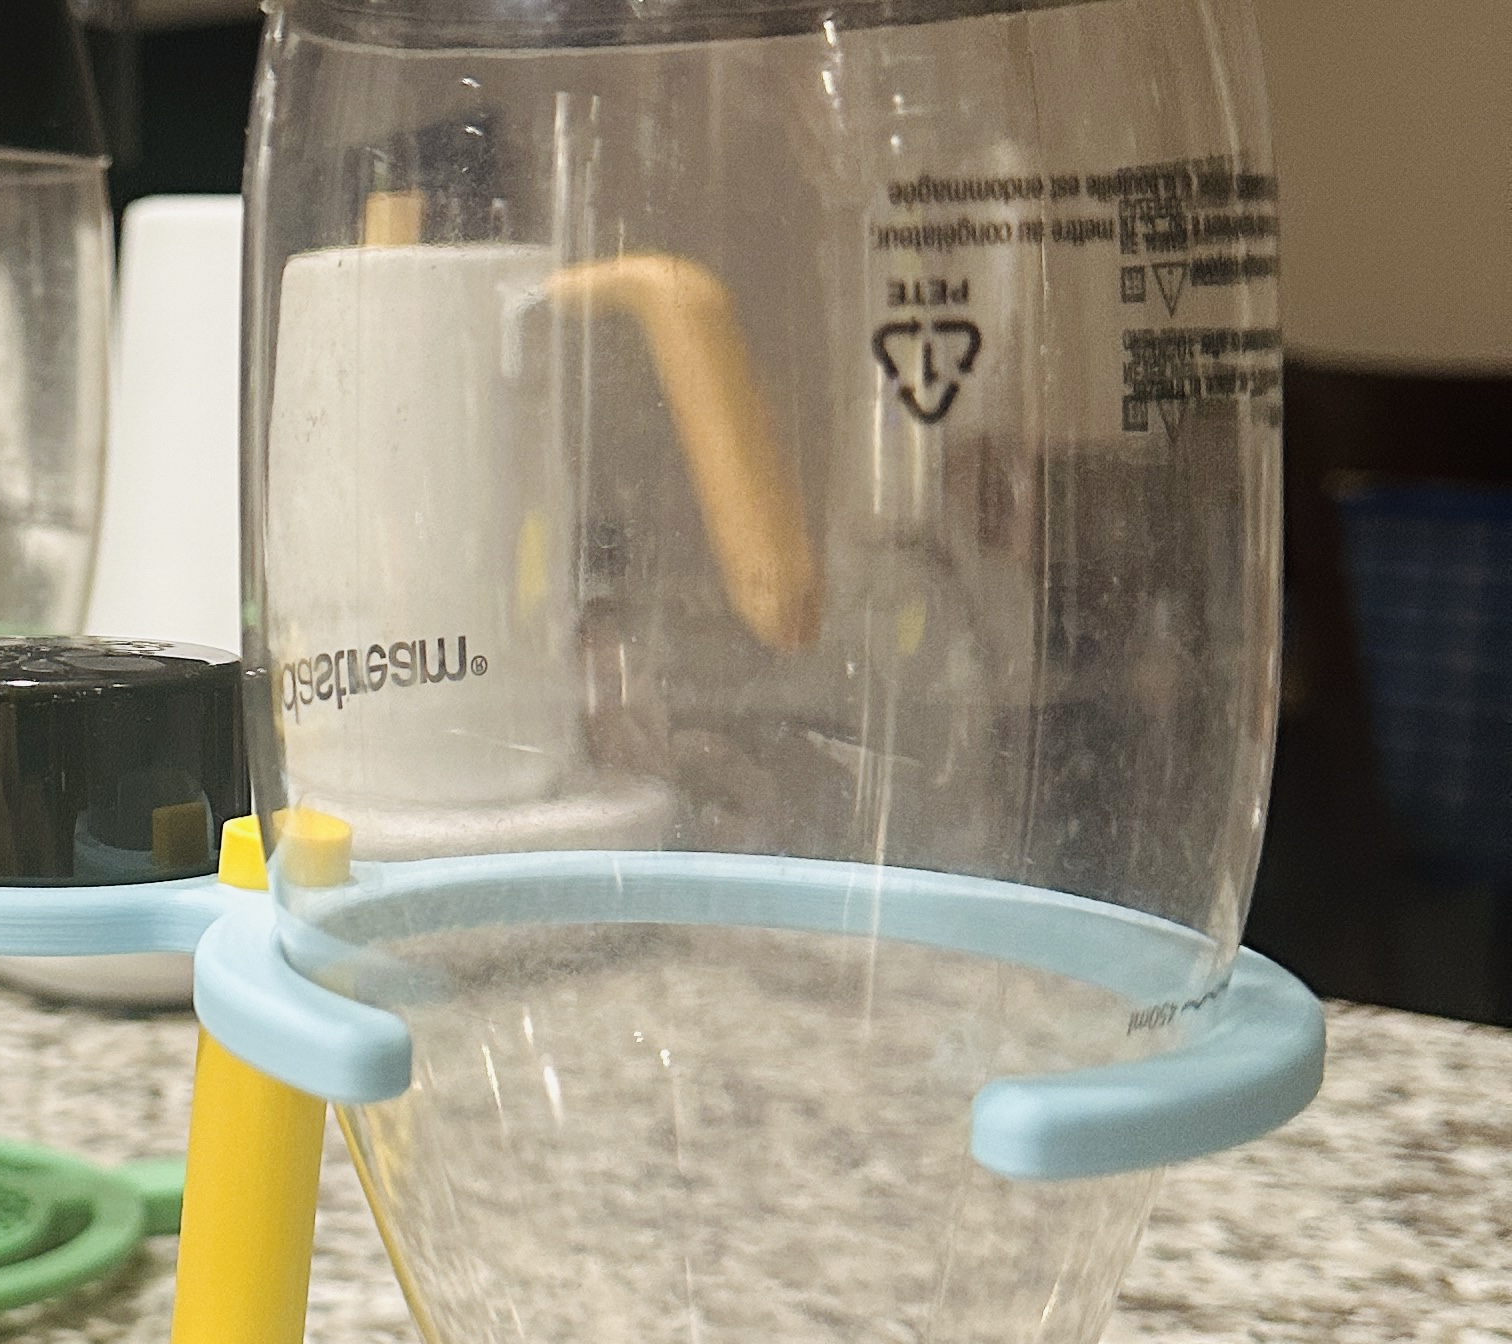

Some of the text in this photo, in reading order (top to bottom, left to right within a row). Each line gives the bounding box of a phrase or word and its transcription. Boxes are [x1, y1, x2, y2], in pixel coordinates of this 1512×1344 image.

[887, 174, 1043, 206] endommagée
[1050, 175, 1079, 202] est
[1018, 221, 1043, 245] au
[887, 279, 969, 307] PETE
